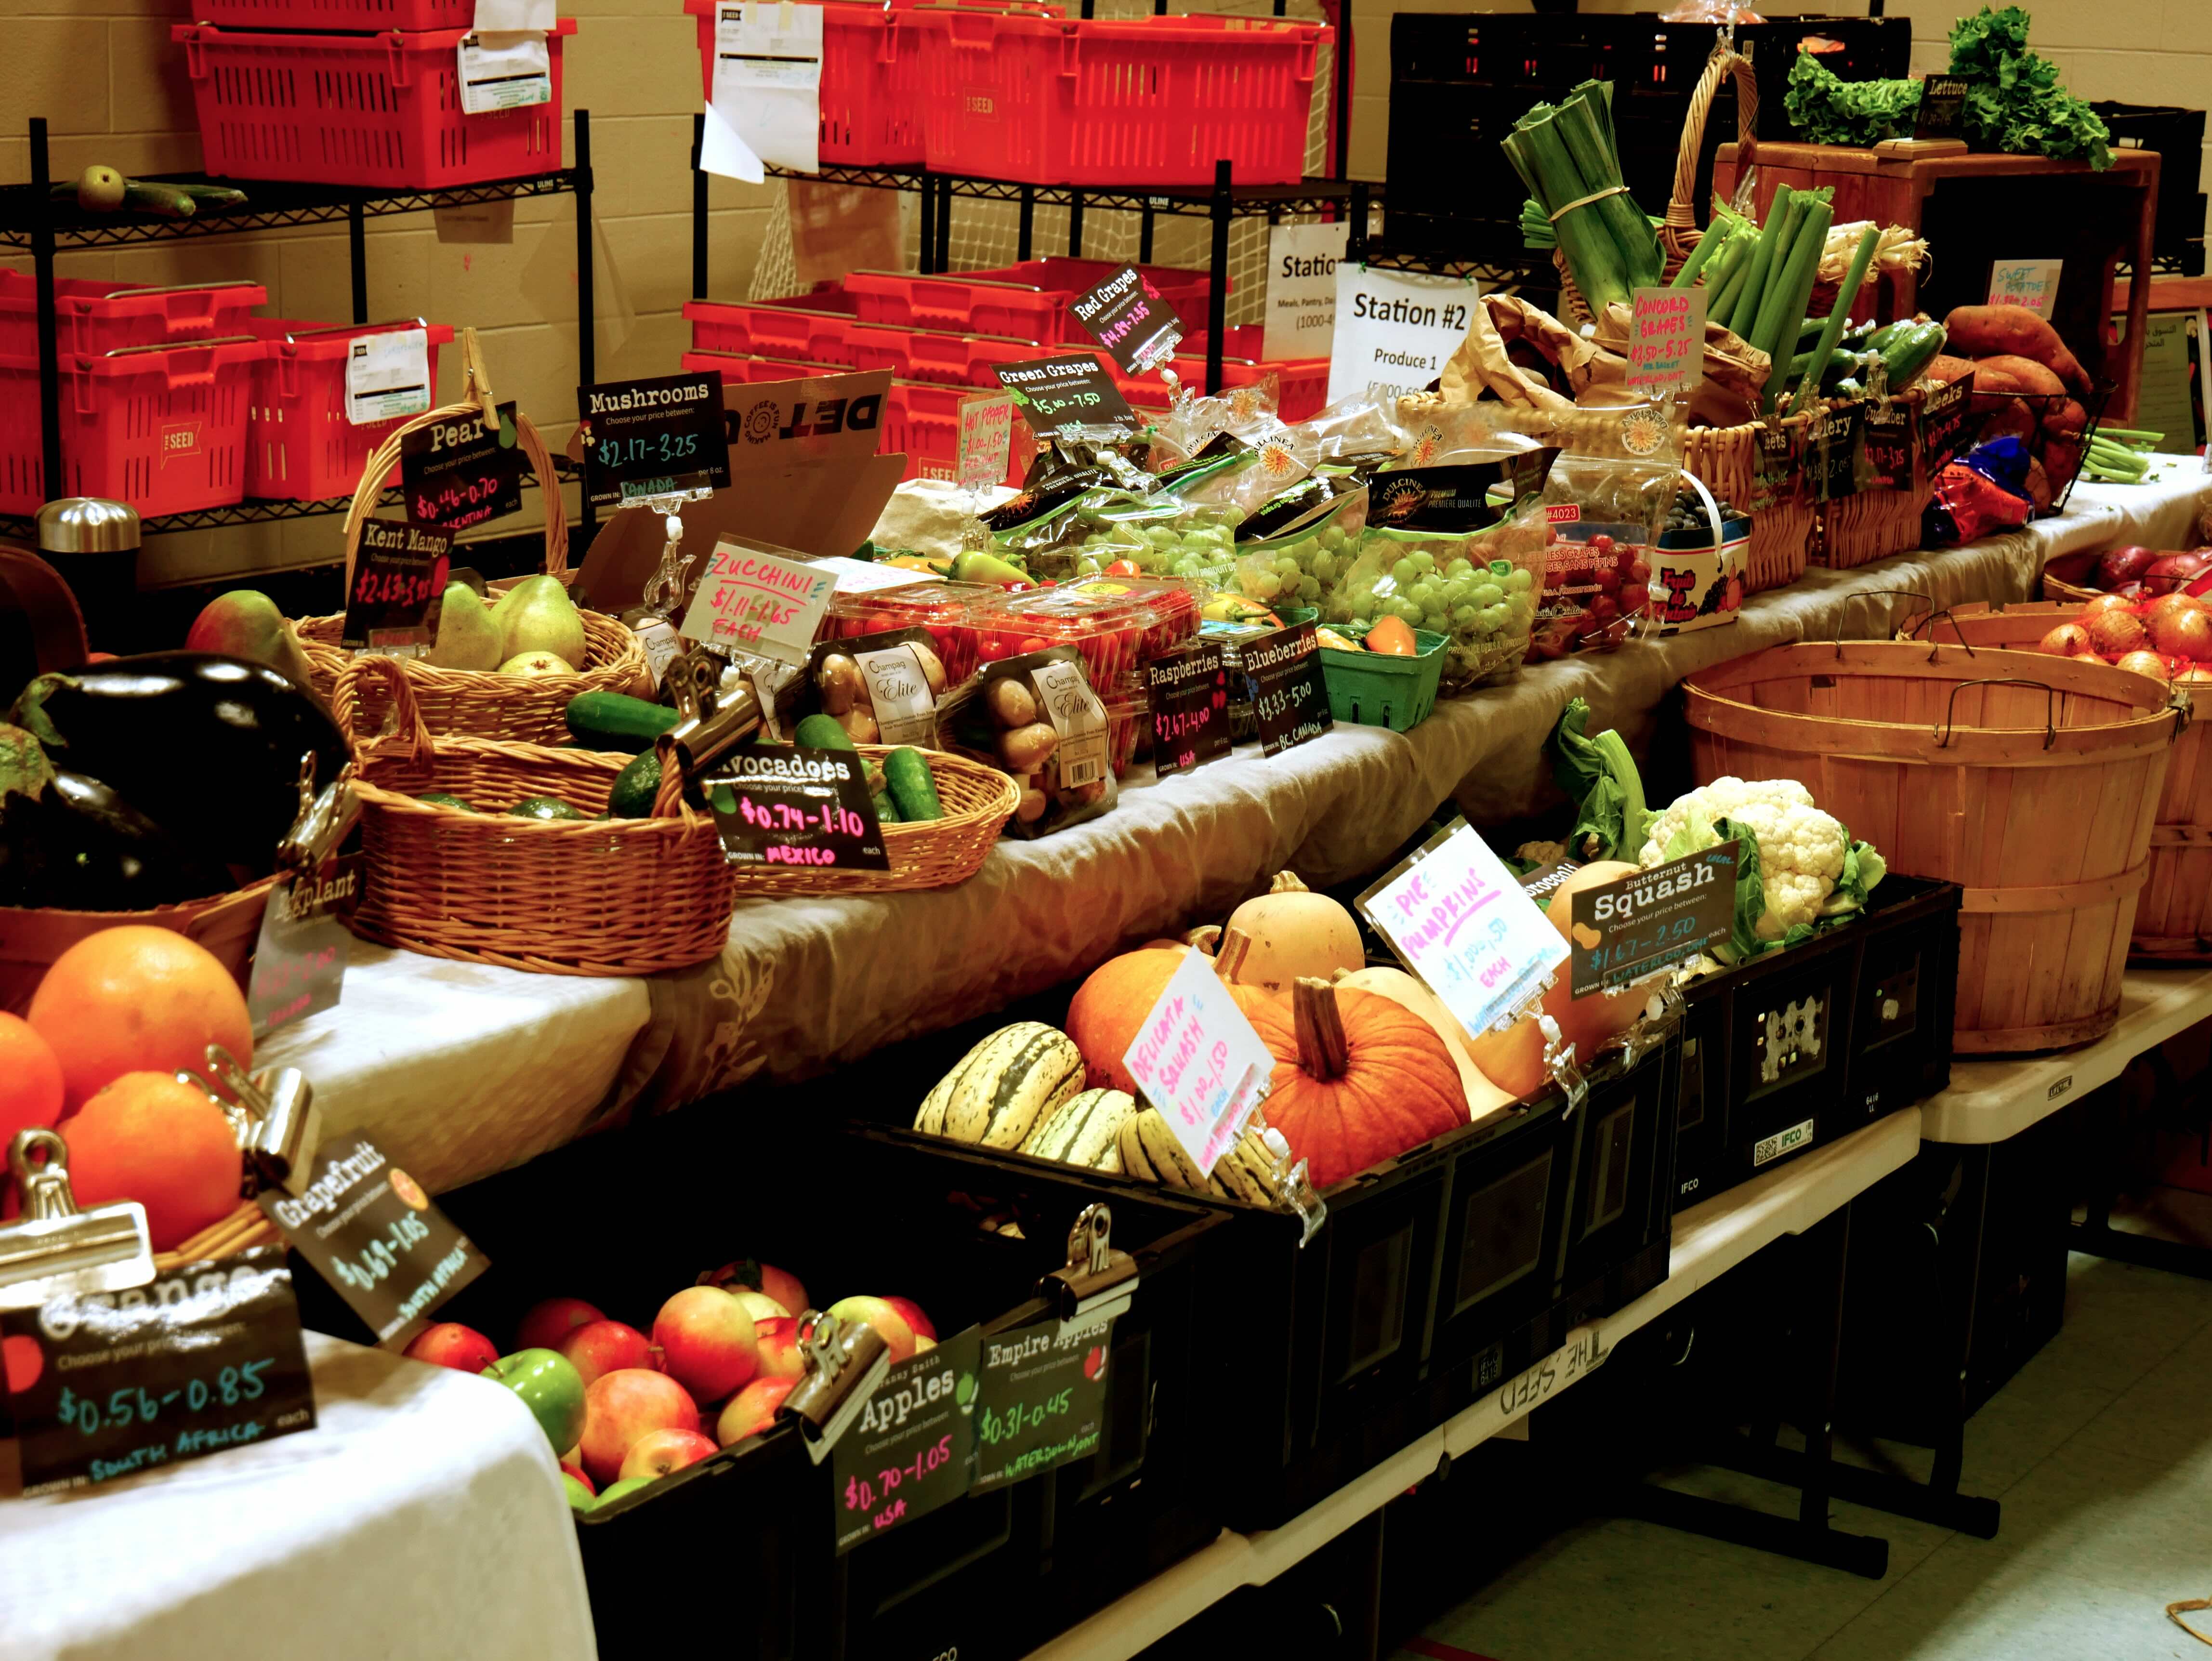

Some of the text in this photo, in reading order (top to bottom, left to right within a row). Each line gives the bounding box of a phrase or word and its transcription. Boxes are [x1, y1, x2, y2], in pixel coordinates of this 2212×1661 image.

[1929, 79, 1968, 95] Lettuce
[972, 97, 993, 114] SEED
[537, 180, 553, 189] ULINE
[1149, 196, 1169, 206] ULINE
[1997, 267, 2037, 283] SWEET
[1074, 269, 1137, 321] Red Grapes
[1278, 297, 1323, 309] Meals, Pantry,
[1635, 295, 1689, 318] CONCORD
[1354, 293, 1466, 331] Station #2
[1099, 301, 1150, 349] $4.89-7.35
[1641, 315, 1685, 339] GRAPES
[1374, 348, 1437, 370] Produce 1
[999, 361, 1099, 384] Green Grapes
[590, 383, 709, 414] Mushrooms
[769, 400, 777, 410] IS
[1032, 393, 1101, 415] $5.00-7.50
[1934, 385, 1963, 410] eeks
[606, 408, 695, 425] Choose your price between:
[744, 400, 769, 428] COFFEE
[771, 409, 780, 429] FUN
[965, 411, 979, 433] HOT
[170, 432, 194, 449] SEED
[598, 433, 698, 468] $2.17-3.25
[967, 431, 1002, 455] $1.00-1.50
[1186, 430, 1219, 455] DULCIN
[1253, 435, 1296, 459] DULCINEA
[424, 463, 444, 475] Choose
[445, 459, 458, 470] your
[458, 454, 472, 465] price
[698, 469, 709, 477] per
[591, 493, 611, 502] GROWN
[623, 477, 678, 497] CANADA
[1383, 478, 1427, 502] DULCINEA
[1430, 488, 1457, 499] PREMIUM
[505, 499, 518, 508] each
[1427, 498, 1482, 509] PREMIÈRE QUALITÉ
[1546, 508, 1577, 520] #4023
[364, 523, 448, 558] Kent Mango
[1566, 546, 1600, 559] GRAPES
[711, 553, 814, 593] ZUCCHINI
[1565, 554, 1619, 571] SANS PÉPINS
[1562, 586, 1584, 595] PRODUIT
[710, 587, 800, 625] $1.11-1.65
[712, 619, 763, 643] EACH
[1245, 633, 1317, 672] Blueberries
[869, 660, 906, 673] Champag
[1149, 654, 1219, 685] Raspberries
[1261, 665, 1294, 683] Choose your price
[876, 677, 917, 702] Elite
[1166, 692, 1180, 700] Choose
[1259, 681, 1312, 721] $3.33-5.00
[1053, 692, 1091, 720] Elite
[1156, 706, 1210, 742] $2.67-4.00
[1292, 721, 1322, 741] CANADA
[1159, 725, 1195, 772] GROWN USA
[764, 784, 781, 793] your
[783, 784, 803, 793] price
[740, 796, 864, 838] $0.74-1.10
[728, 844, 836, 865] GROWN IN: MEXICO
[862, 846, 881, 856] each
[1625, 862, 1687, 891] Butternut
[1396, 874, 1428, 917] PIE
[1594, 862, 1715, 921] Squash
[1401, 867, 1486, 960] PUMPKINS
[1608, 894, 1708, 934] Choose your price between:
[1590, 917, 1697, 971] $1.67-2.50
[1709, 927, 1726, 939] each
[1479, 956, 1512, 988] EACH
[1575, 981, 1600, 995] GROWN
[1132, 995, 1184, 1083] DELICATA
[1159, 1014, 1206, 1095] SQUASH
[1782, 1128, 1802, 1147] IFCO
[275, 1140, 386, 1229] Grapefruit
[1681, 1178, 1699, 1195] IFCO
[56, 1342, 146, 1371] Choose your
[988, 1334, 1050, 1368] Empire
[879, 1355, 941, 1388] ranny Smith
[58, 1358, 276, 1435] $0.56-0.85
[858, 1369, 955, 1434] Apples
[276, 1409, 310, 1428] each
[980, 1387, 1074, 1444] $0.31-0.45
[90, 1444, 167, 1482] SOUTH
[176, 1421, 266, 1453] AFRICA
[845, 1434, 953, 1511] $0.70-1.05
[873, 1498, 908, 1529] USA
